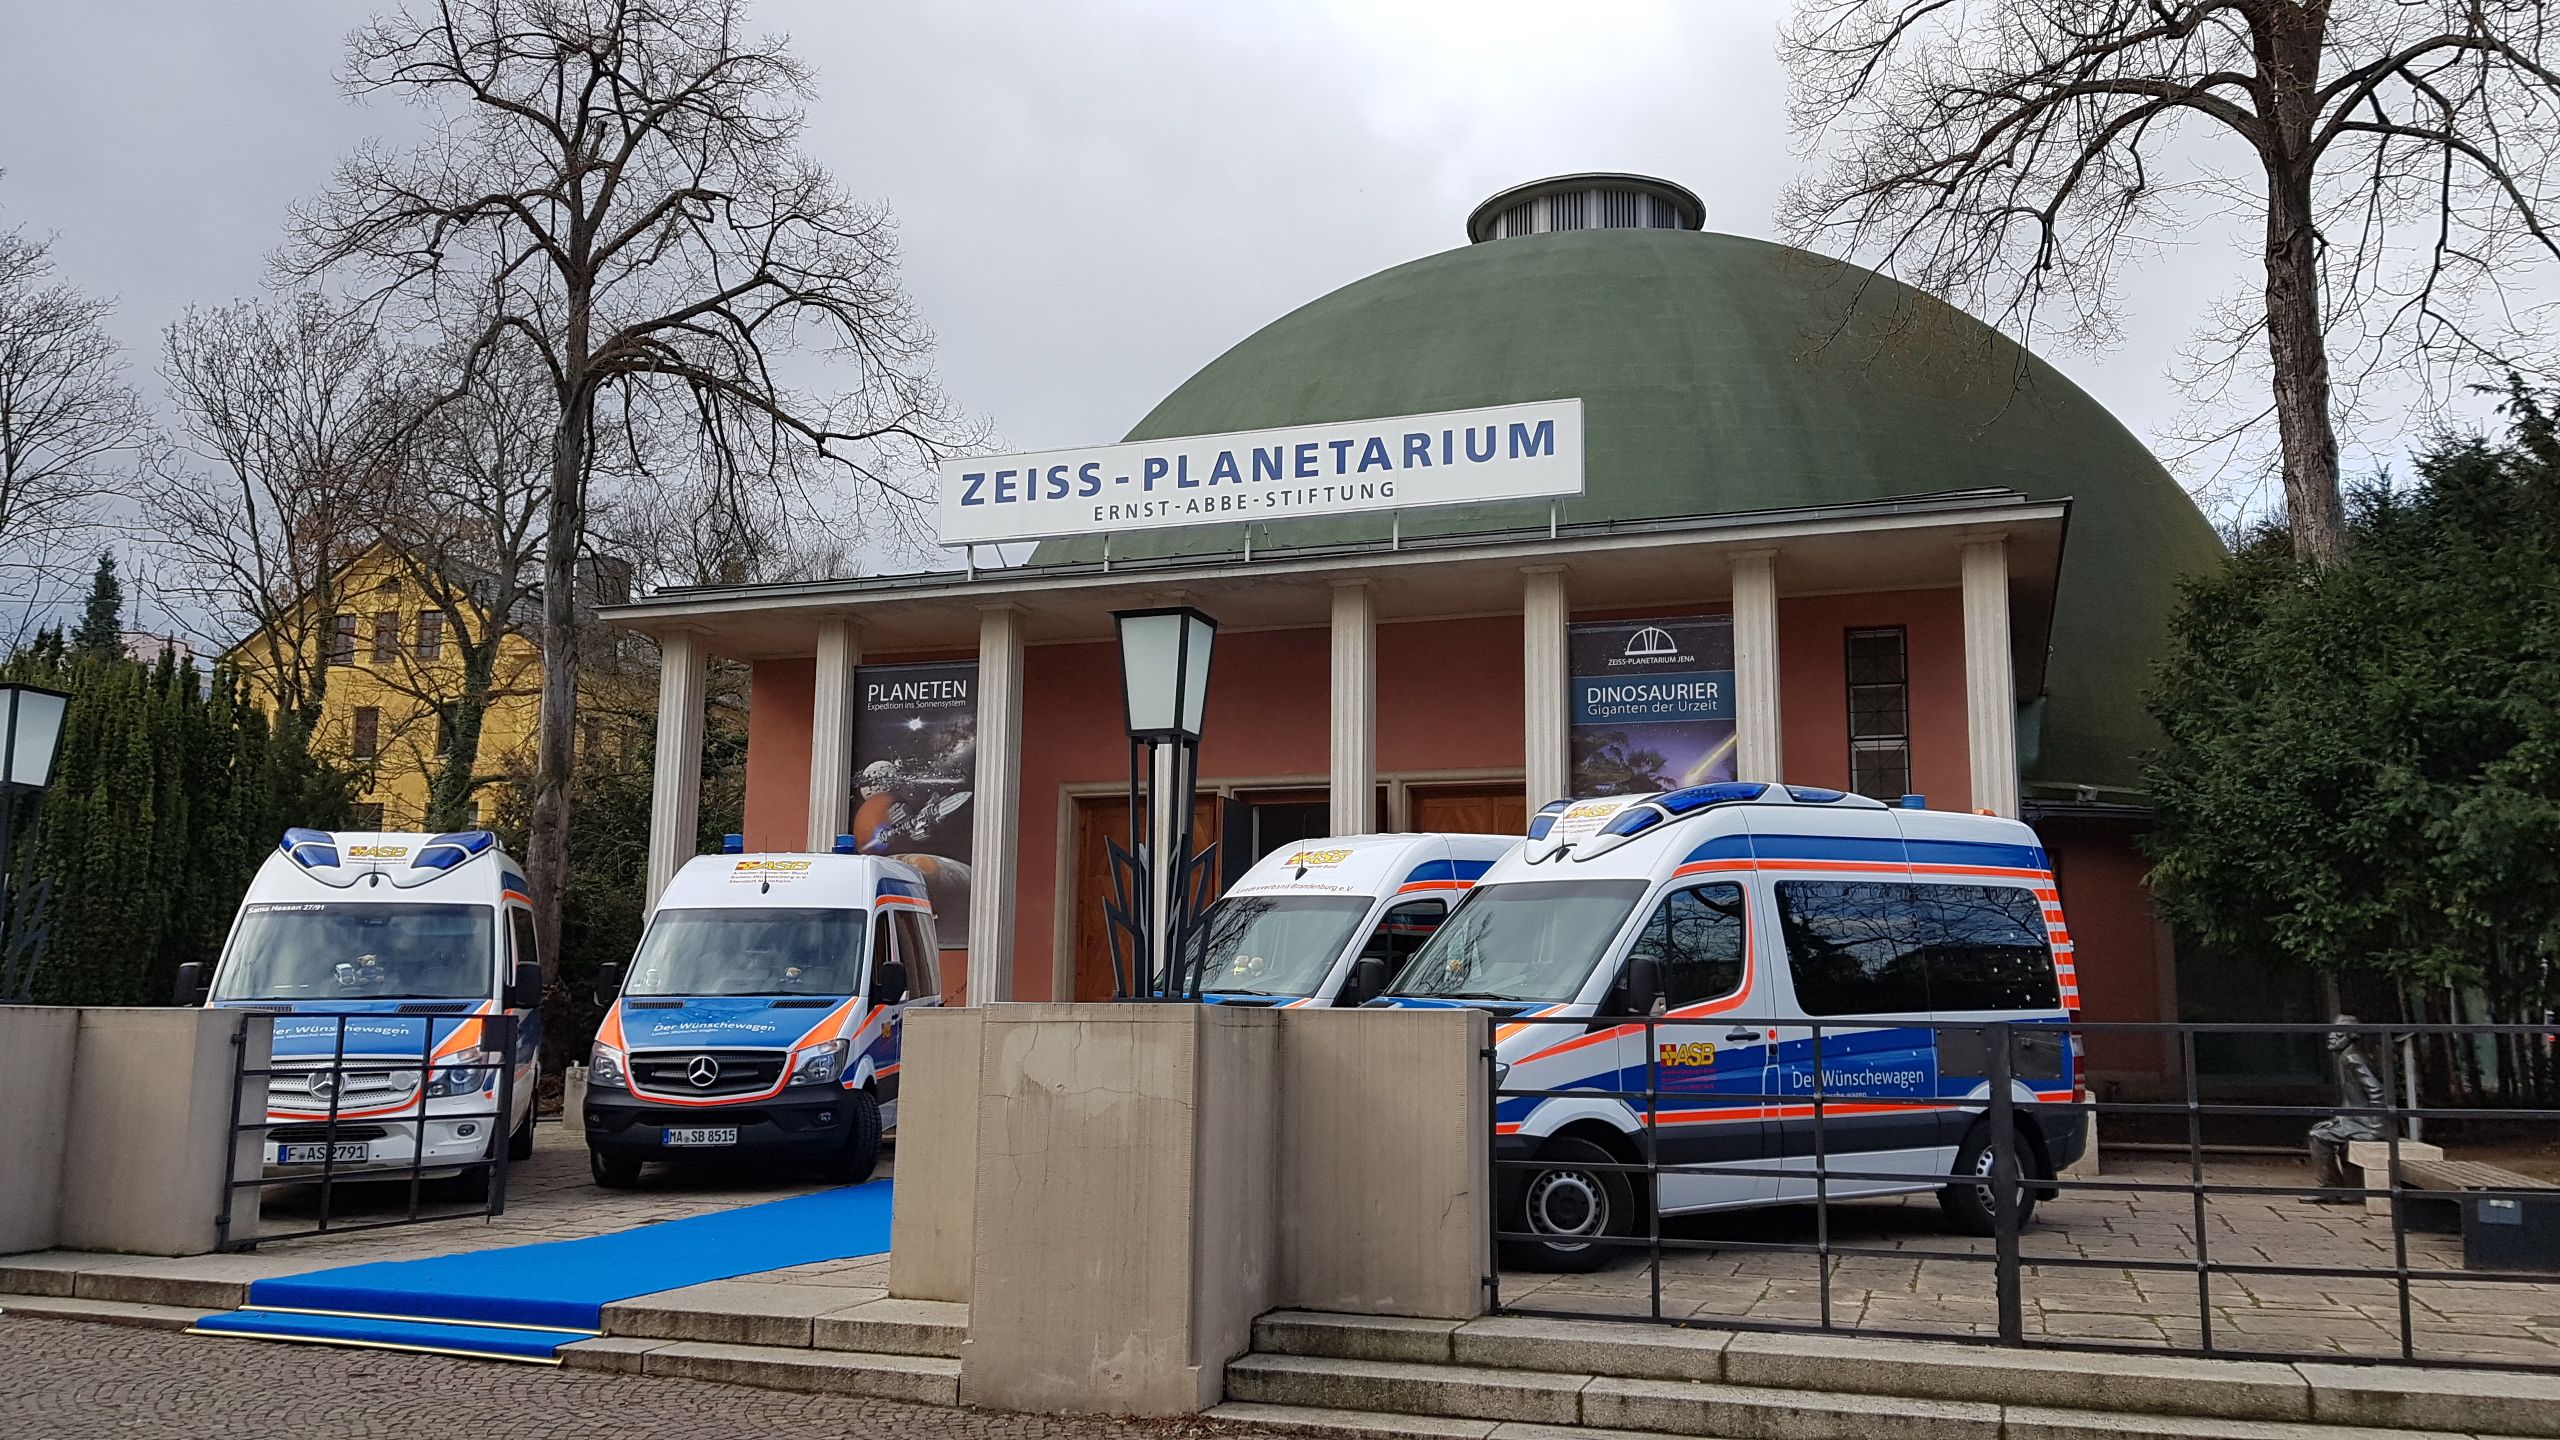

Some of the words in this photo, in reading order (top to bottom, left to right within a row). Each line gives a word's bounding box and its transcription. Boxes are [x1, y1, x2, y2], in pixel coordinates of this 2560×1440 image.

[1092, 480, 1396, 522] ERNST-ABBE-STIFTUNG
[1607, 656, 1677, 667] ZEISS-PLANETARIUM
[1677, 655, 1695, 664] JENA
[867, 679, 967, 702] PLANETEN
[1586, 682, 1719, 704] DINOSAURIER
[867, 702, 904, 712] Expedition
[904, 701, 915, 709] ins
[915, 699, 966, 709] Sonnensystem
[1587, 703, 1647, 718] Giganten
[1651, 701, 1674, 713] der
[1678, 699, 1718, 713] Urzeit
[1291, 883, 1338, 892] Brandenburg
[271, 904, 302, 912] Hessen
[273, 1026, 291, 1036] er
[295, 1023, 410, 1037] Wünshewagen
[653, 1024, 678, 1033] Der
[680, 1021, 776, 1033] Wünschewagen
[1676, 1042, 1716, 1067] ASB
[1821, 1068, 1924, 1089] Wünschewagen
[669, 1130, 683, 1143] MA
[690, 1130, 705, 1143] SB
[708, 1129, 735, 1143] 8515
[288, 1147, 298, 1161] F
